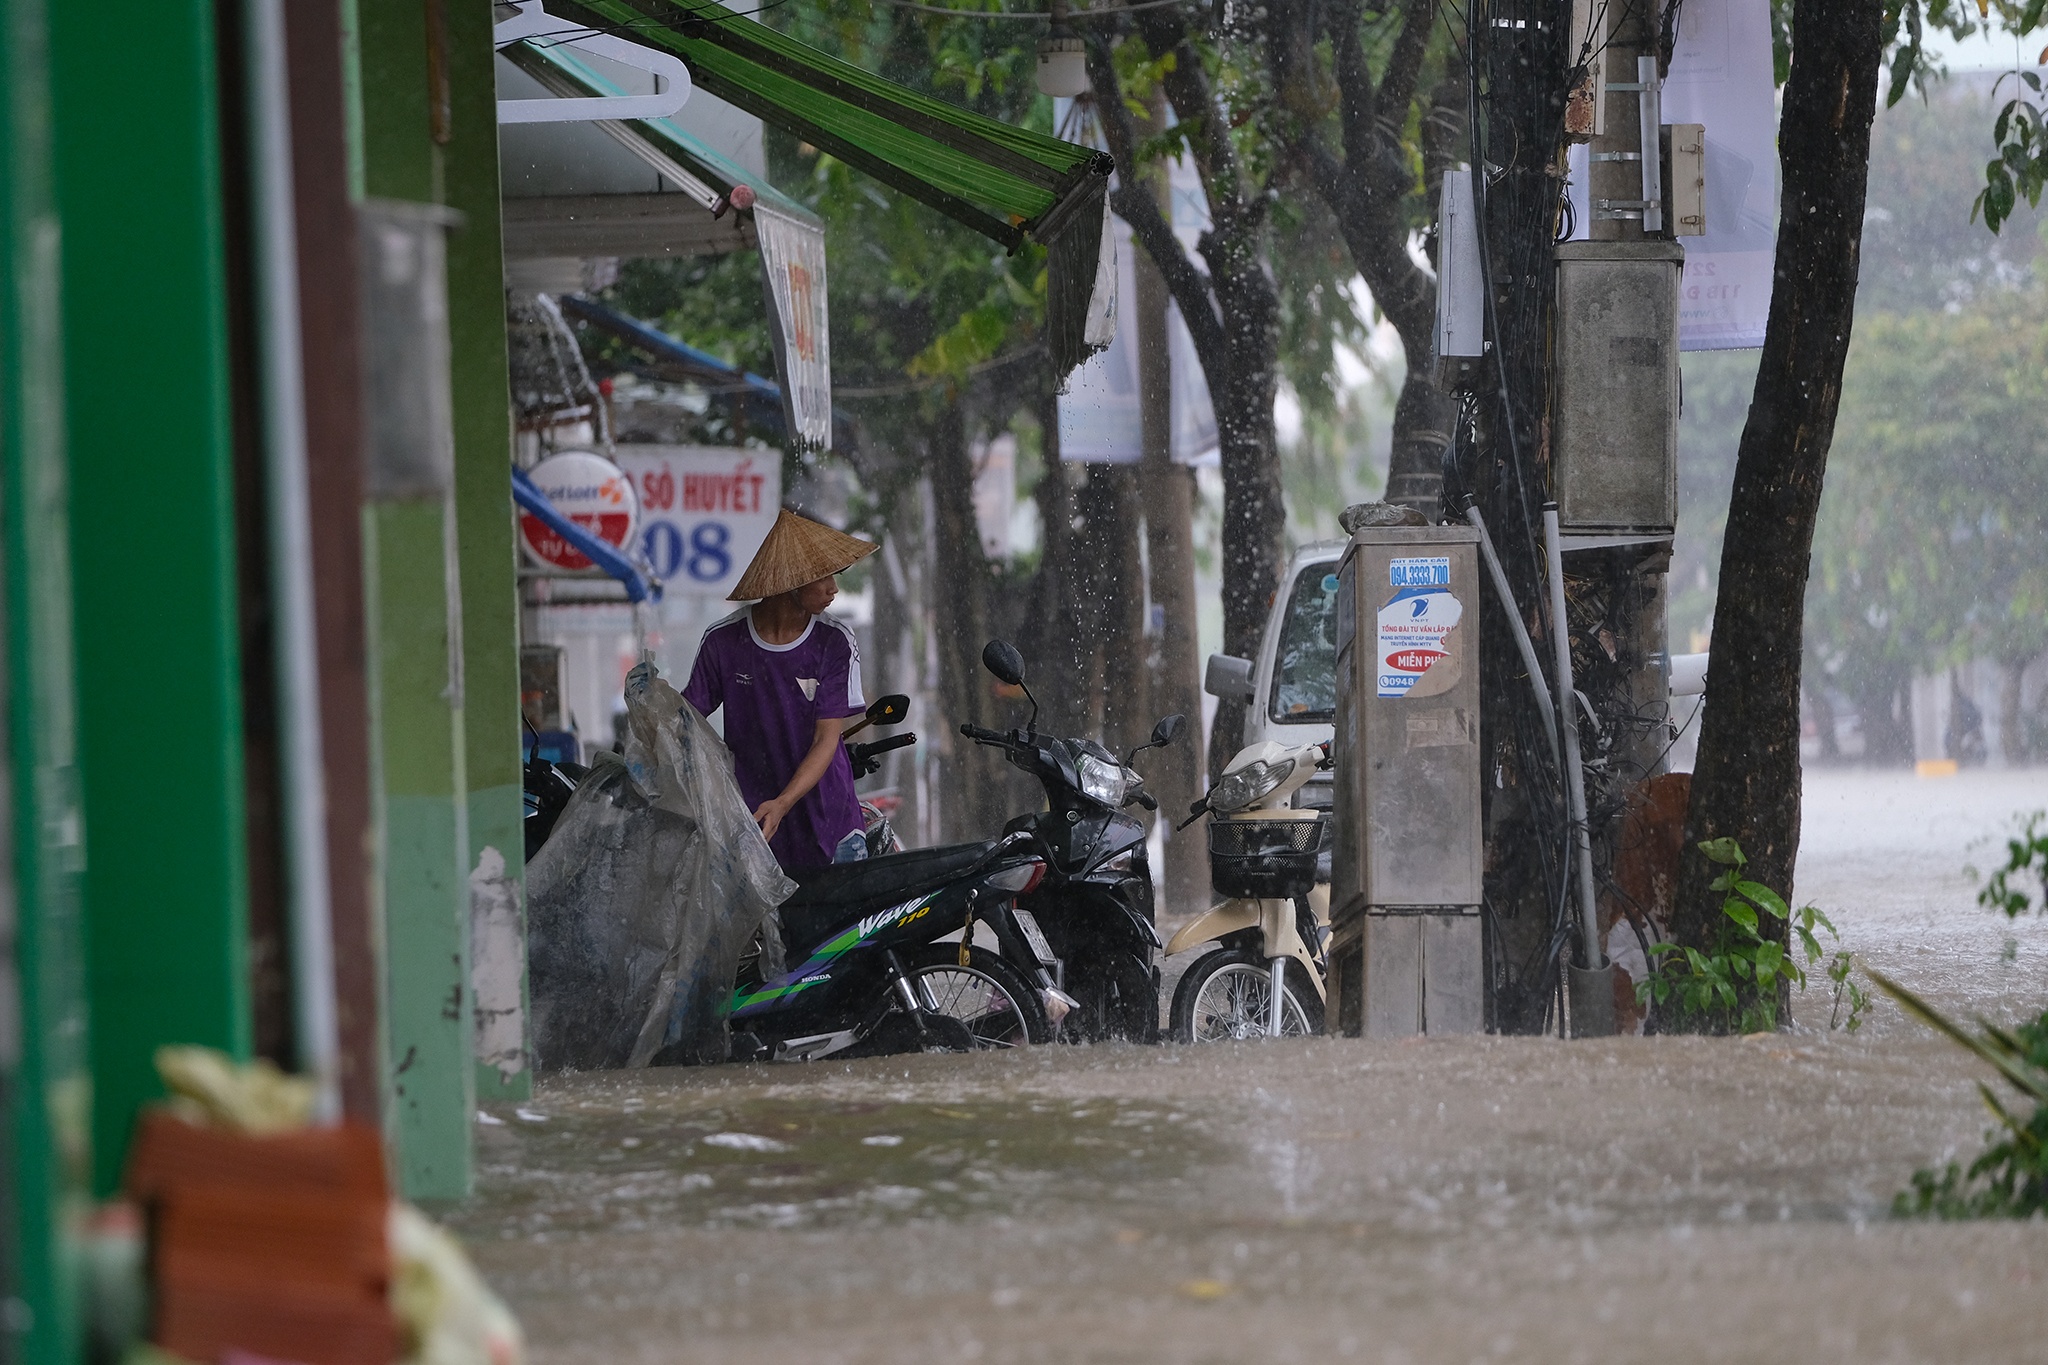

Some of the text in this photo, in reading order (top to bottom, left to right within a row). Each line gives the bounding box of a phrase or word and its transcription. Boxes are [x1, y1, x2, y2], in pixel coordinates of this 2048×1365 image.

[683, 458, 765, 513] HUYẾT
[642, 520, 732, 583] 08
[1391, 565, 1448, 585] 094.3333.700
[1398, 652, 1422, 667] MIỄN
[1389, 676, 1414, 685] 0948
[858, 894, 931, 938] Wave
[897, 906, 931, 928] 110
[801, 973, 832, 983] HONDA
